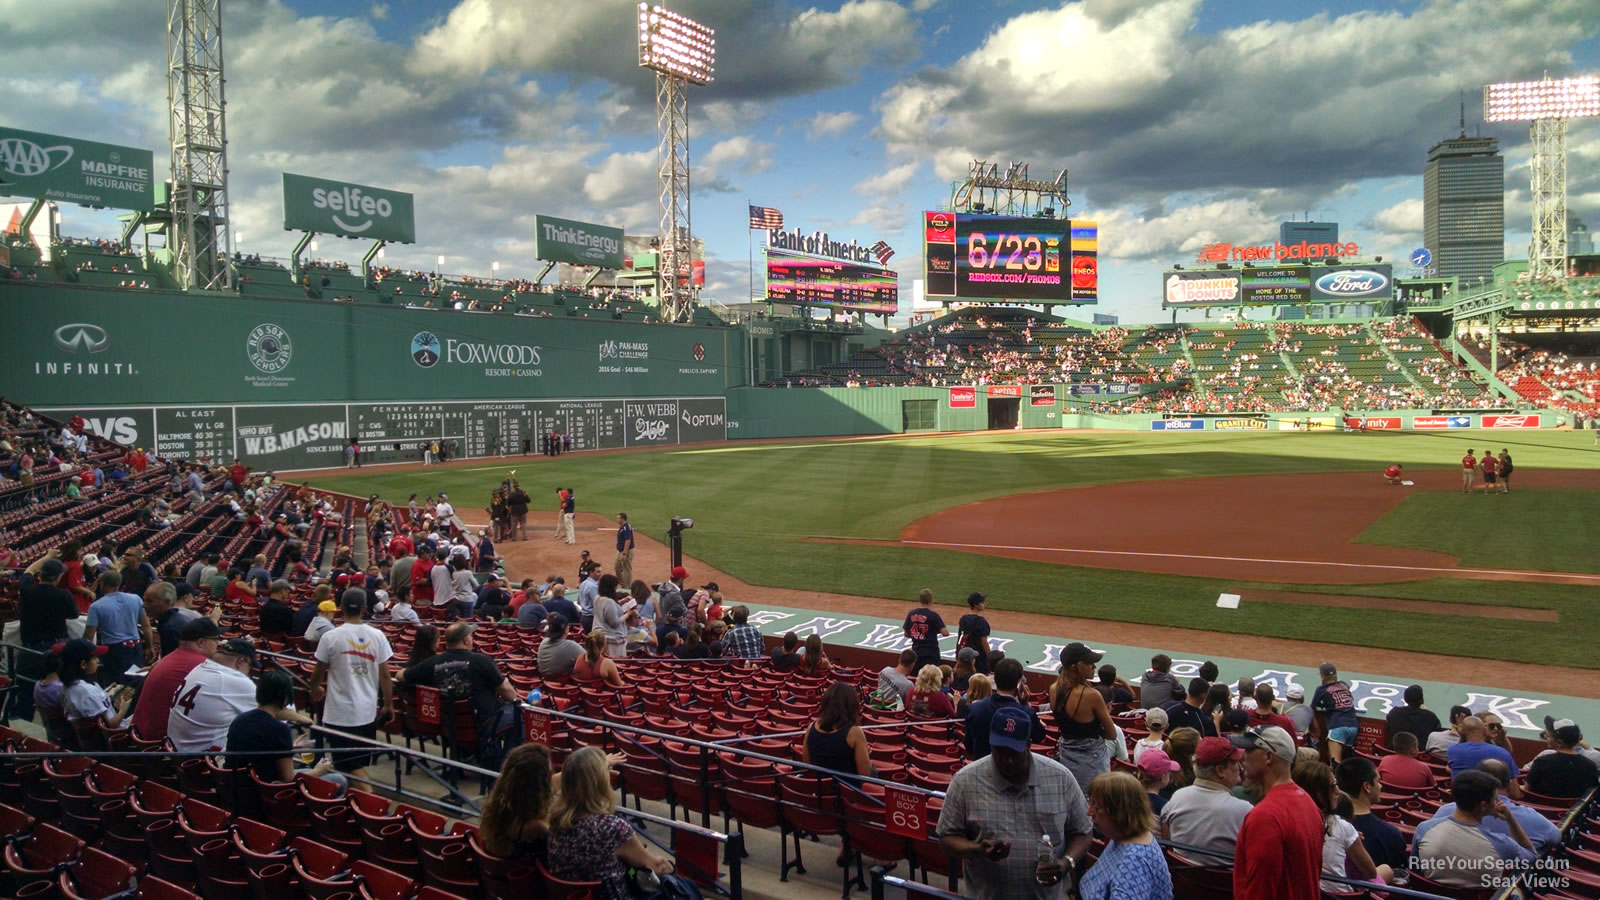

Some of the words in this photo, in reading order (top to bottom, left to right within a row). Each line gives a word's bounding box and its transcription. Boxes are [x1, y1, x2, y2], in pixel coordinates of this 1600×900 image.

[82, 160, 149, 180] MAPFRE
[86, 176, 145, 192] INSURANCE
[46, 188, 65, 199] Auto
[66, 190, 102, 202] Insurance
[312, 185, 392, 217] selfeo
[543, 223, 618, 254] ThinkEnergy
[768, 228, 805, 251] Bank
[806, 232, 820, 253] of
[821, 232, 870, 264] America
[968, 232, 1042, 270] 6/23
[1232, 245, 1273, 261] new
[1274, 240, 1360, 260] balance
[968, 272, 1060, 284] REDSOX.COM/PROMOS
[1329, 273, 1374, 292] Ford
[1187, 279, 1236, 291] DUNKIN'
[1187, 288, 1233, 299] DONUTS
[249, 328, 264, 347] RED
[265, 326, 284, 339] SOX
[446, 337, 541, 366] FOXWOODS
[619, 342, 649, 351] PAN-MASS
[251, 344, 290, 371] SCHOLARS
[619, 351, 649, 359] CHALLENGE
[35, 361, 134, 376] INFINITI
[485, 367, 511, 377] RESORT
[515, 368, 542, 378] CASINO
[993, 387, 1017, 396] aetna
[1031, 390, 1054, 398] Safelite
[175, 410, 188, 418] AL
[191, 410, 216, 418] EAST
[372, 405, 413, 413] FENWAY
[626, 403, 645, 417] F.W.
[646, 402, 677, 417] WEBB
[194, 422, 204, 430] W
[205, 422, 212, 430] L
[213, 421, 225, 429] GB
[369, 422, 382, 430] CWS
[691, 414, 724, 427] OPTUM
[726, 421, 739, 429] 379
[1165, 419, 1192, 430] jetBlue
[1215, 419, 1249, 430] GRANITE
[1249, 418, 1268, 429] CITY
[83, 416, 138, 445] VS
[158, 433, 193, 441] BALTIMORE
[194, 432, 204, 440] 40
[204, 431, 214, 439] 30
[238, 427, 257, 437] WHO
[258, 426, 273, 435] BUT
[365, 430, 386, 439] BOSTON
[158, 442, 185, 450] BOSTON
[195, 441, 204, 449] 39
[205, 440, 213, 448] 31
[306, 445, 328, 454] SINCE
[381, 444, 394, 452] BALL
[400, 443, 418, 451] STRIKE
[159, 450, 190, 459] TORONTO
[195, 450, 204, 458] 39
[205, 449, 214, 457] 34
[911, 623, 929, 640] 47
[1332, 690, 1354, 710] 15
[421, 705, 437, 718] 65
[529, 712, 547, 723] FIELD
[531, 719, 545, 728] BOX
[530, 729, 547, 743] 64
[892, 792, 920, 804] FIELD
[895, 801, 916, 812] BOX
[892, 810, 920, 830] 63
